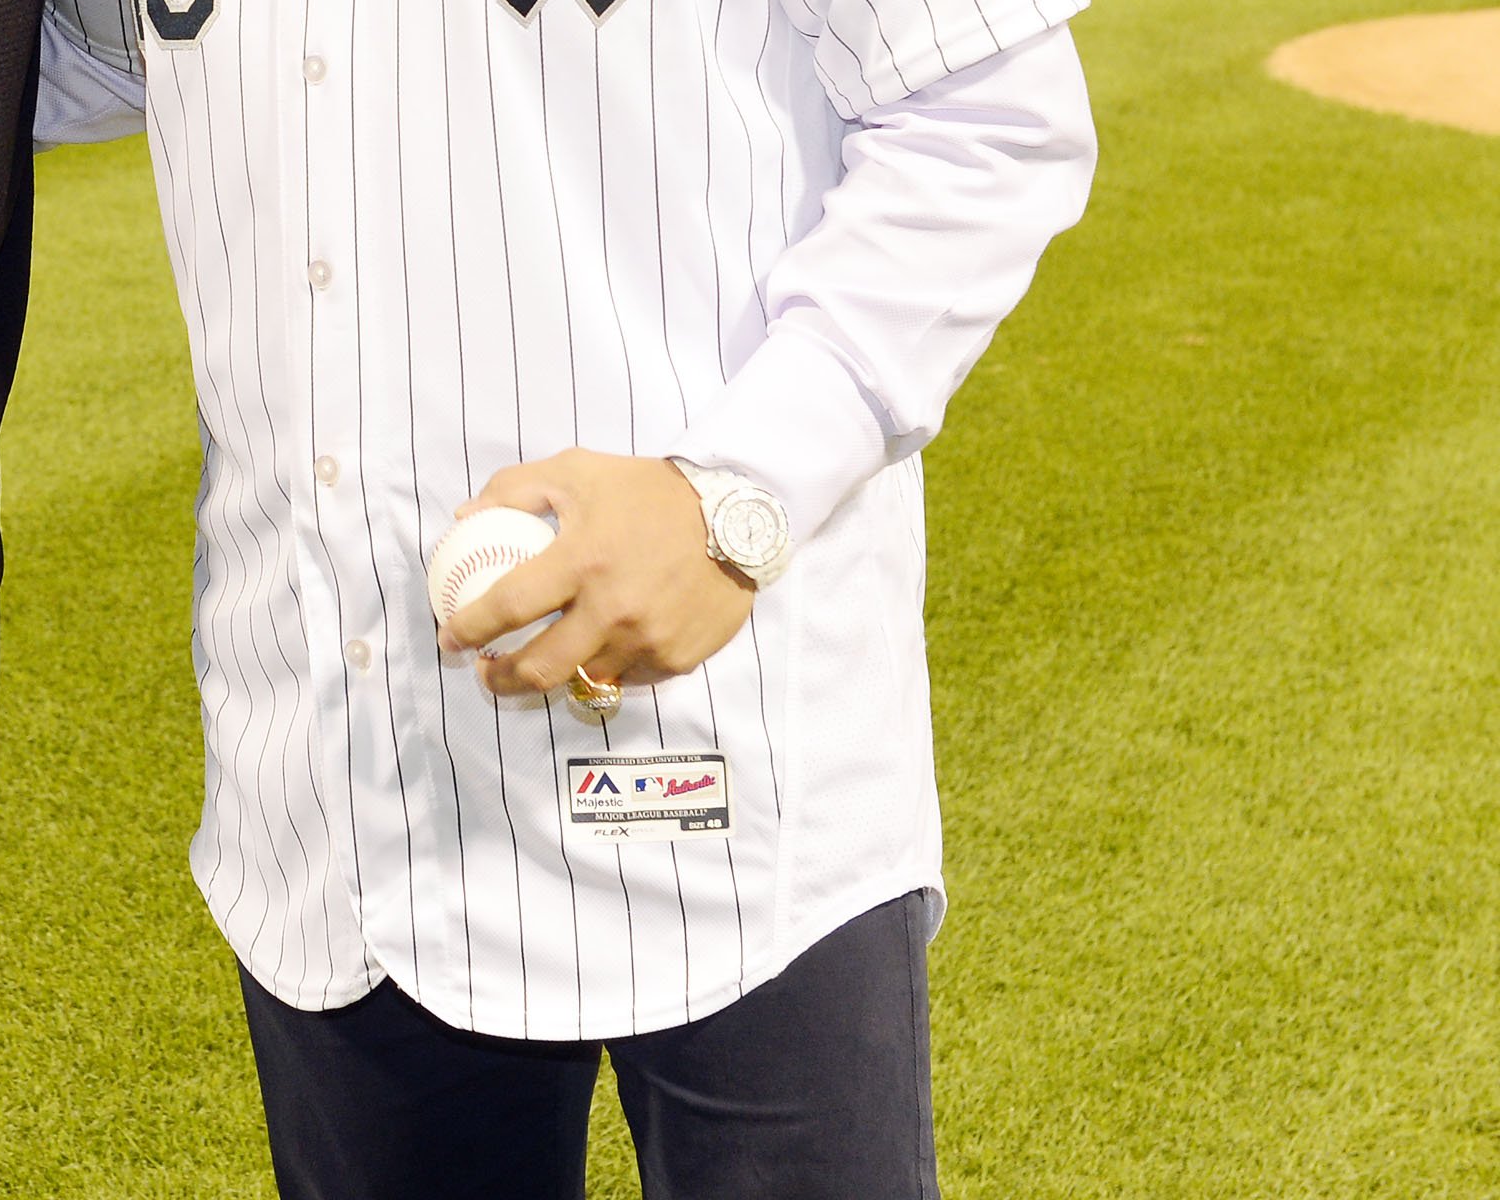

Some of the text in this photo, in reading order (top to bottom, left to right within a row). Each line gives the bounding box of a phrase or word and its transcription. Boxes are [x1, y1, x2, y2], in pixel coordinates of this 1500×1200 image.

[588, 755, 702, 766] ENGINEERED EXCLUSIVELY FOR
[576, 797, 624, 810] Majestic
[595, 808, 708, 821] MAJOR LEAGUE BASEBALL
[688, 821, 706, 830] SIZE
[594, 826, 630, 837] FLEX
